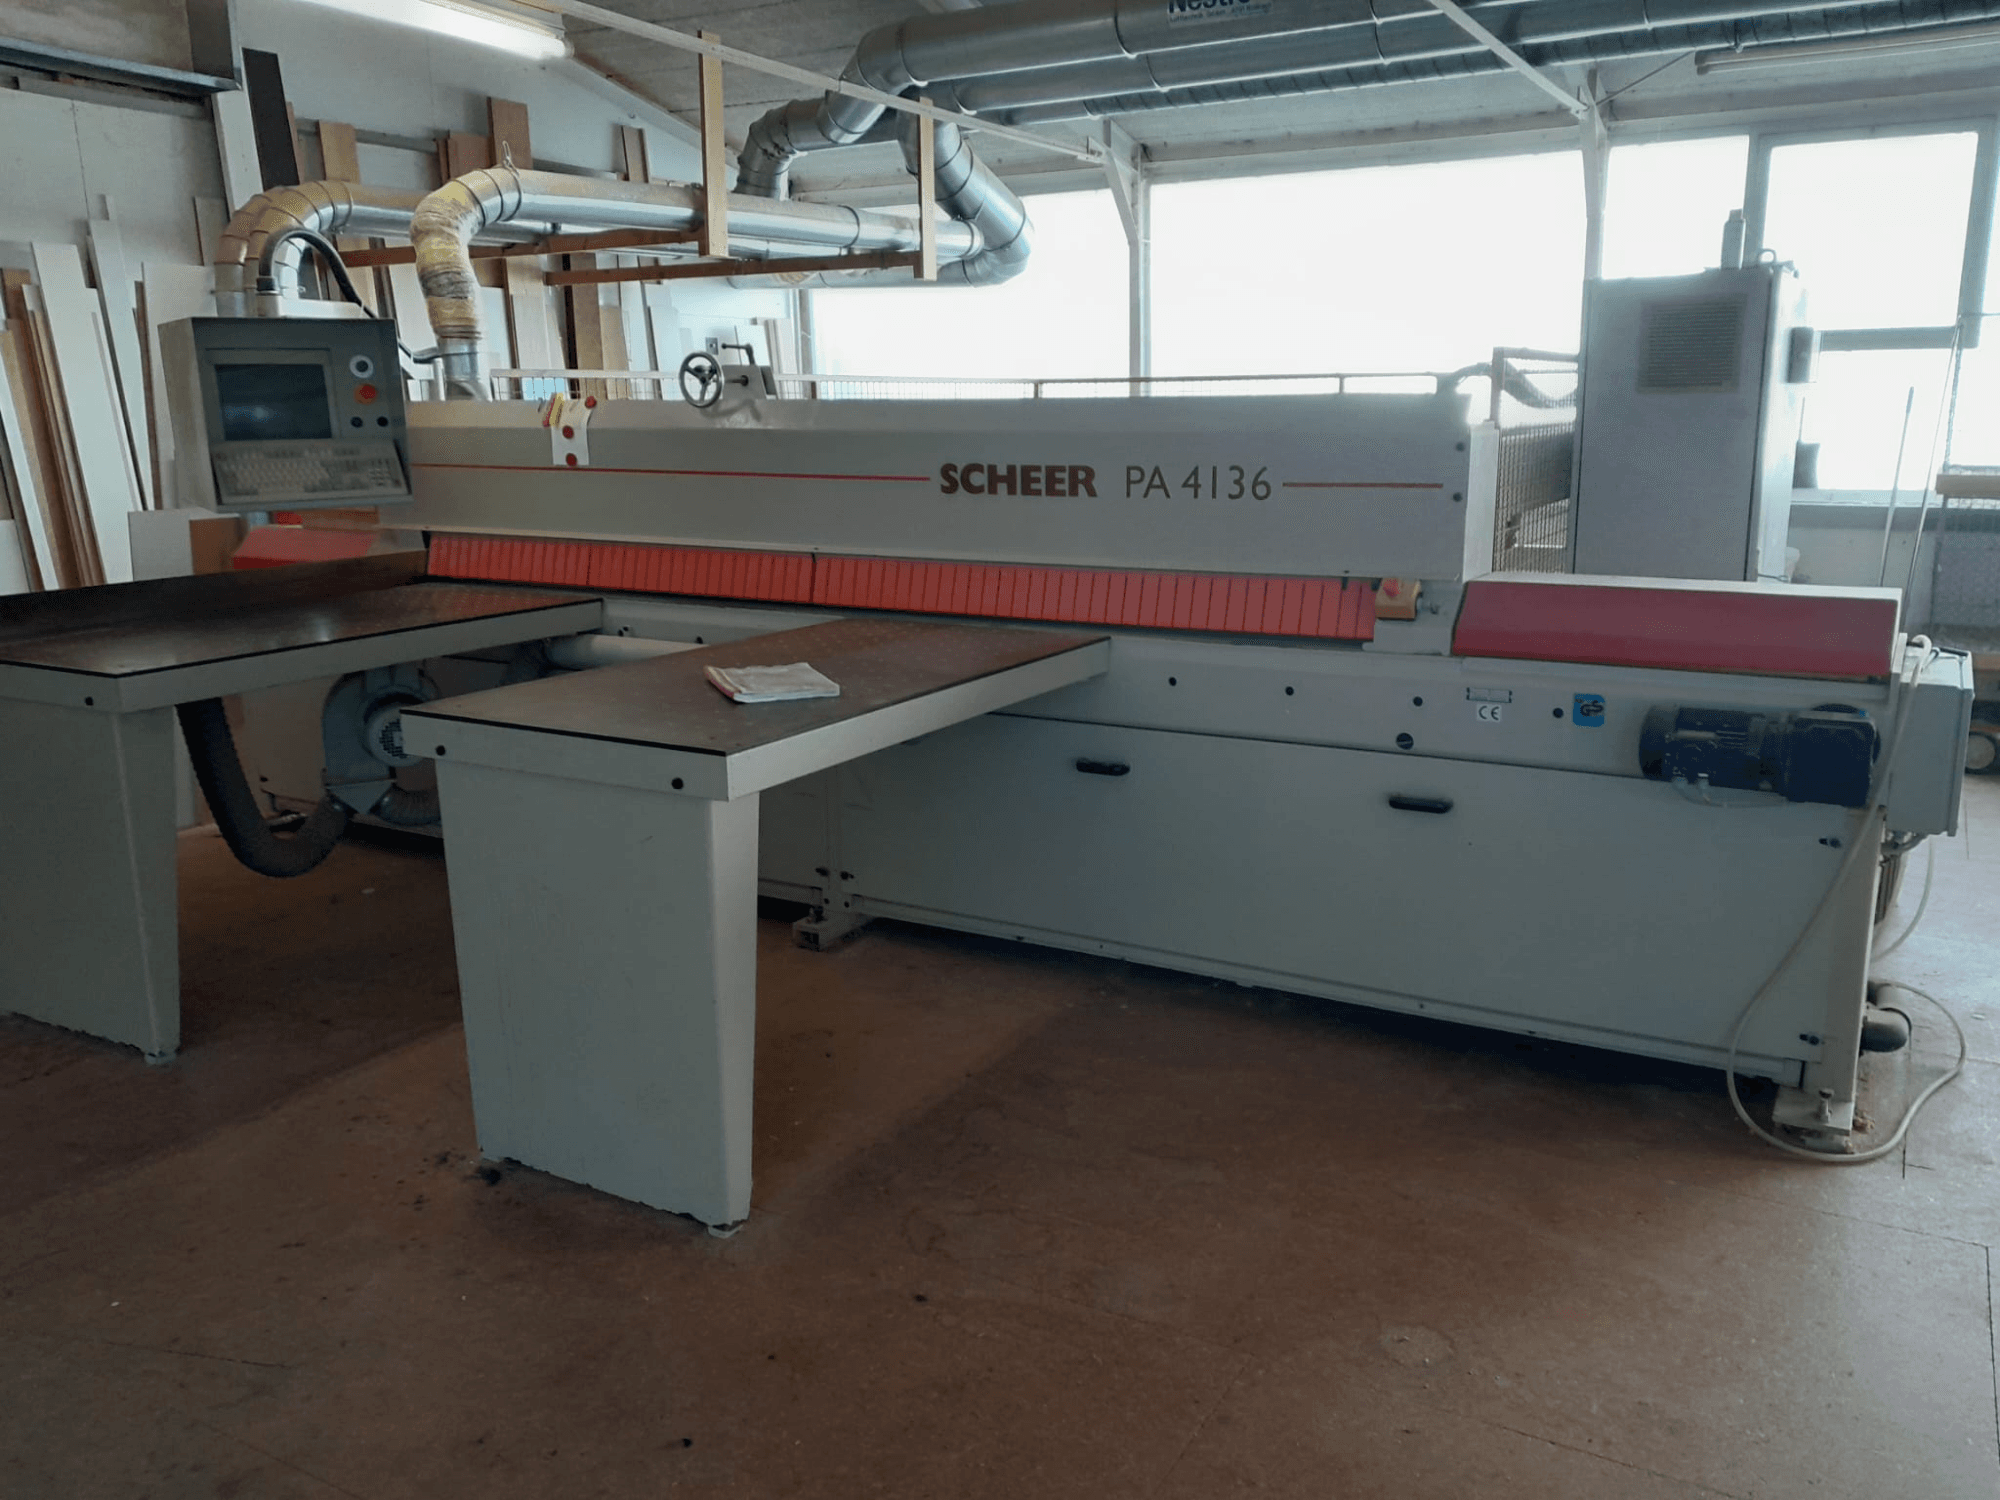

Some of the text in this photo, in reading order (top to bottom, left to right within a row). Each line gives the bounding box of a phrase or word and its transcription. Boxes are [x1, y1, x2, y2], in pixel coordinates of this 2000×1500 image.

[1169, 0, 1250, 13] Nes
[940, 463, 1272, 501] SCHEER PA 4136
[1478, 705, 1500, 721] CE
